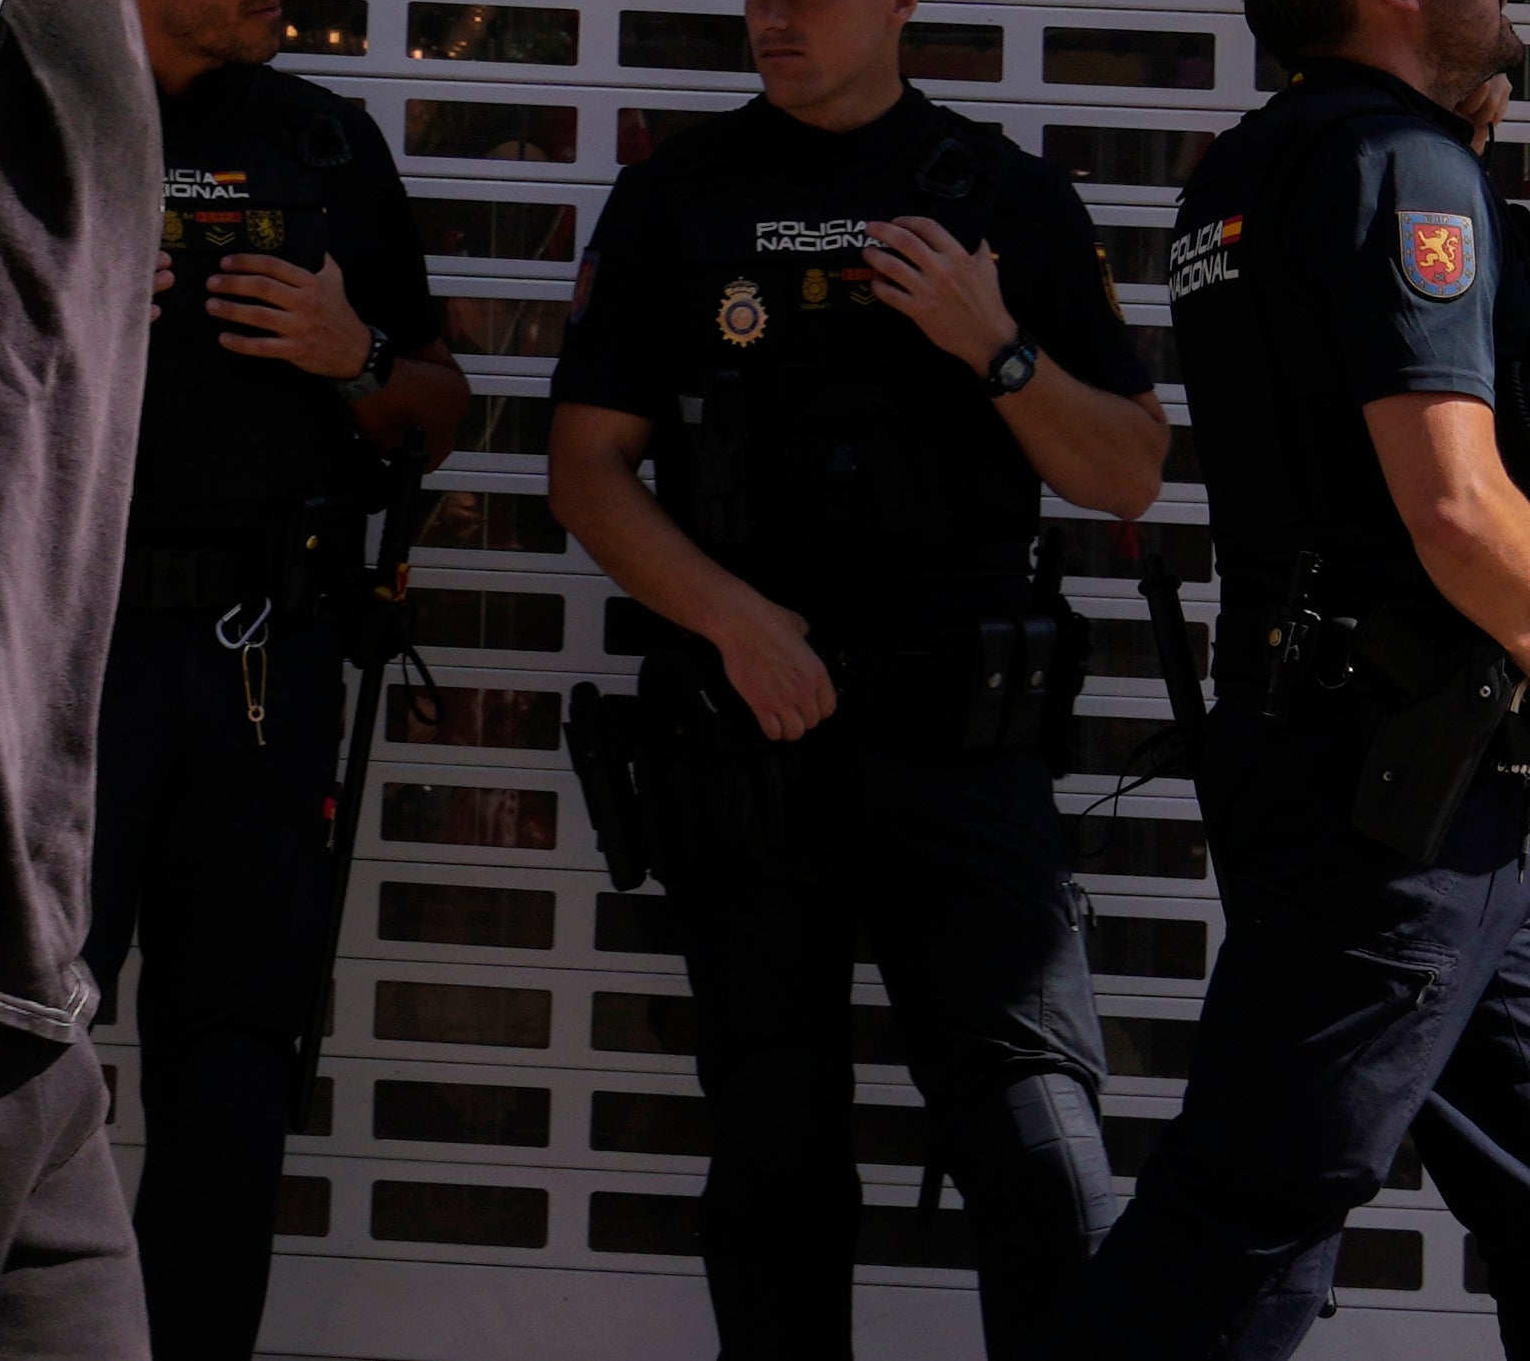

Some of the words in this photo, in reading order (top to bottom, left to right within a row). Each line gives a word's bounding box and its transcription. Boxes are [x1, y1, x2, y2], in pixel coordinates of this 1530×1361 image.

[164, 183, 250, 200] IONAL
[755, 234, 888, 253] NACIONA
[1169, 219, 1224, 271] POLICIA
[1169, 250, 1240, 301] NACIONAL
